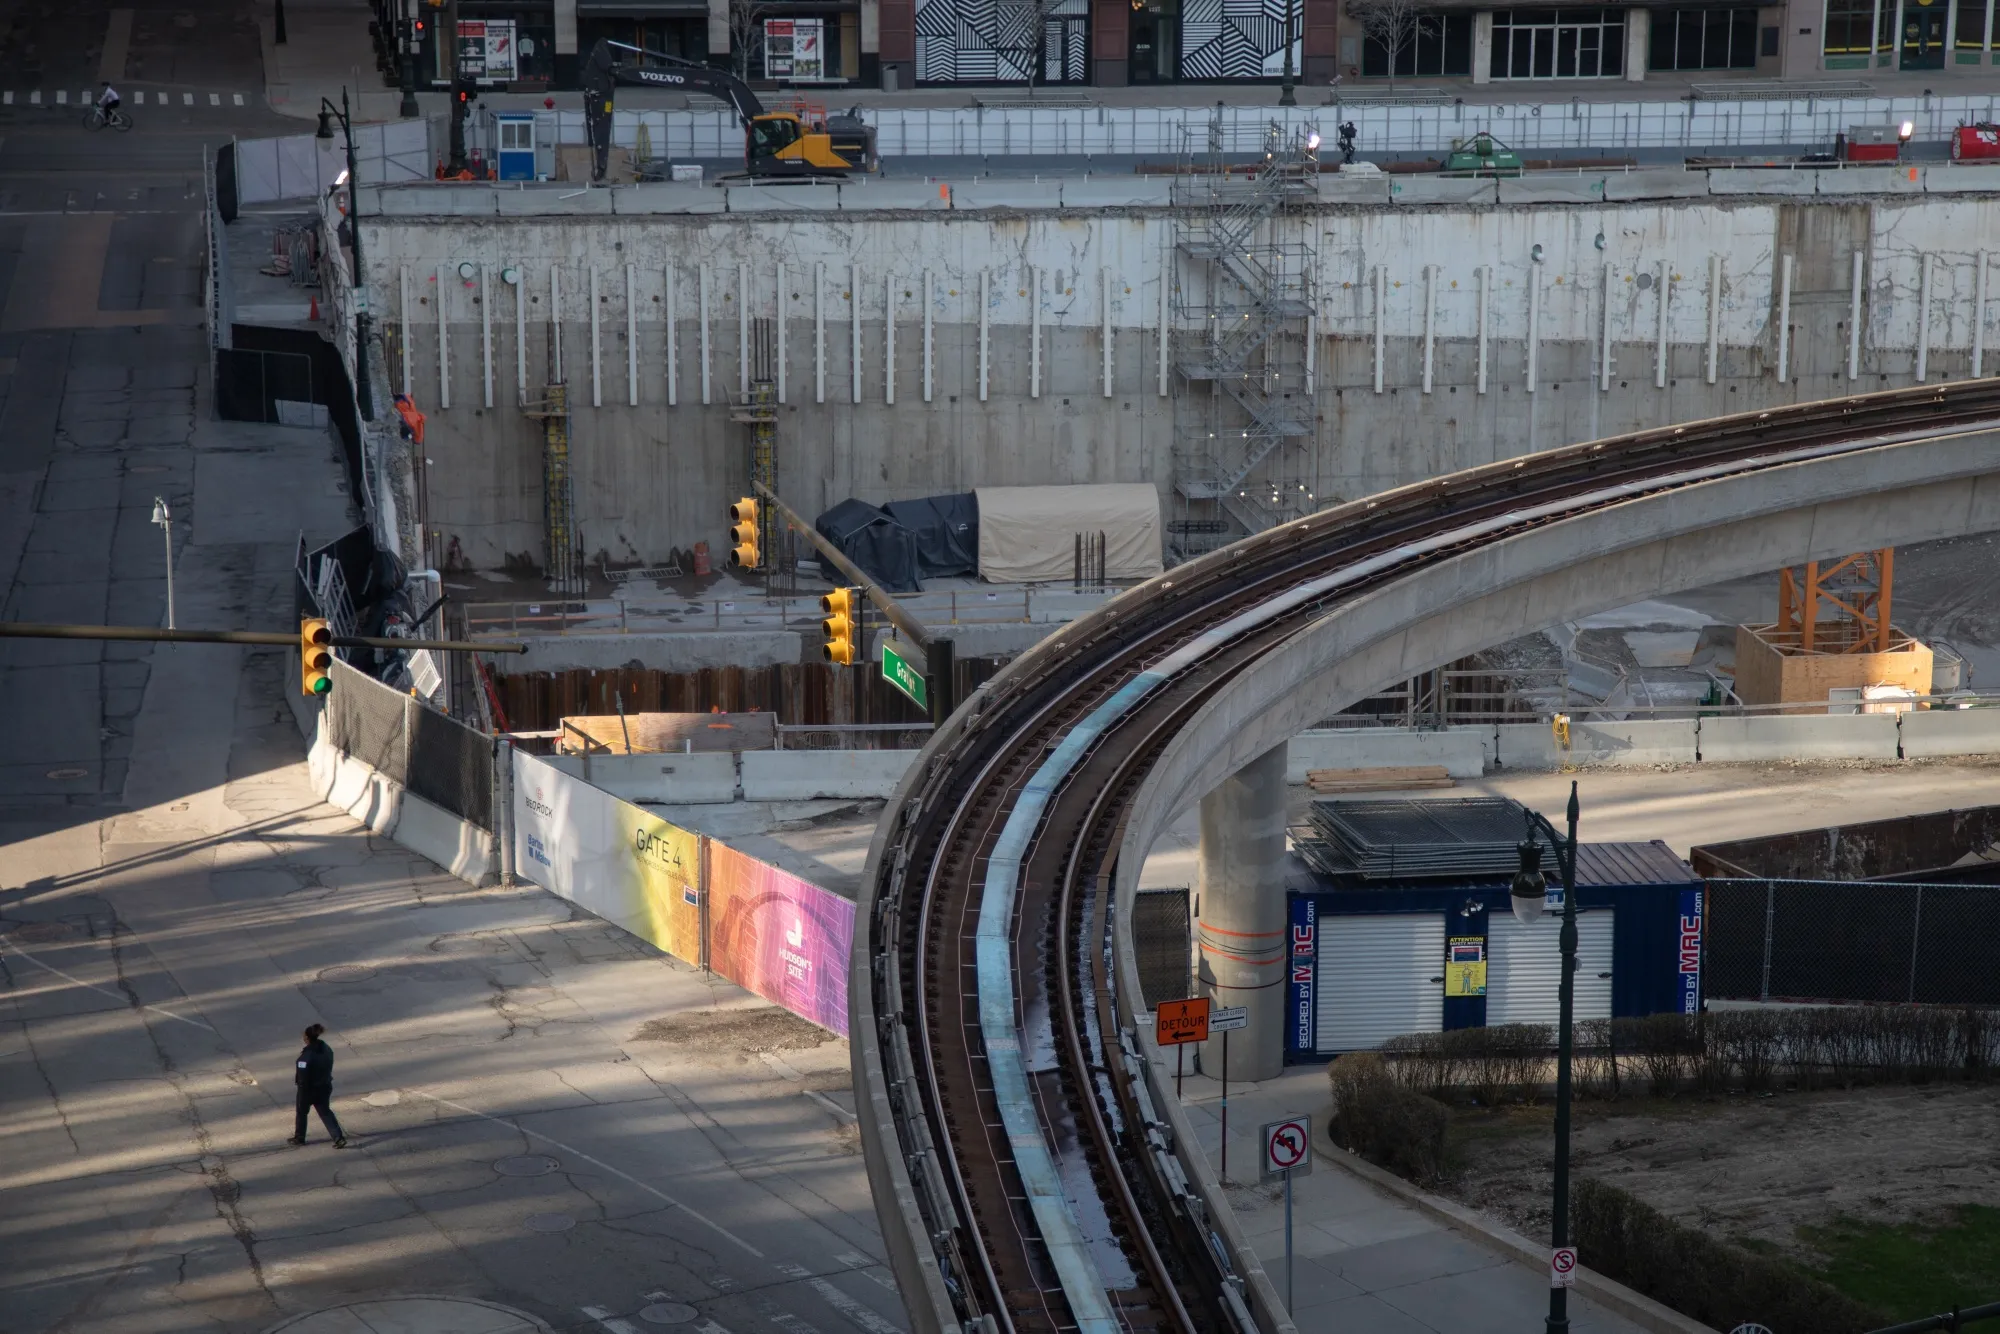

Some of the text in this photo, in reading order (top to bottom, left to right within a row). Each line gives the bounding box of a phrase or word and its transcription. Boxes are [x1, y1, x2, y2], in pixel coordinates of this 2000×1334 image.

[639, 72, 684, 84] VOLVO
[525, 796, 553, 818] BEDROCK
[636, 828, 681, 868] GATE 4
[779, 948, 812, 972] HUDSON'S
[788, 964, 804, 980] SITE
[1686, 974, 1696, 988] BY
[1300, 984, 1309, 998] BY
[1161, 1016, 1205, 1030] DETOUR
[1299, 1001, 1308, 1048] SECURED
